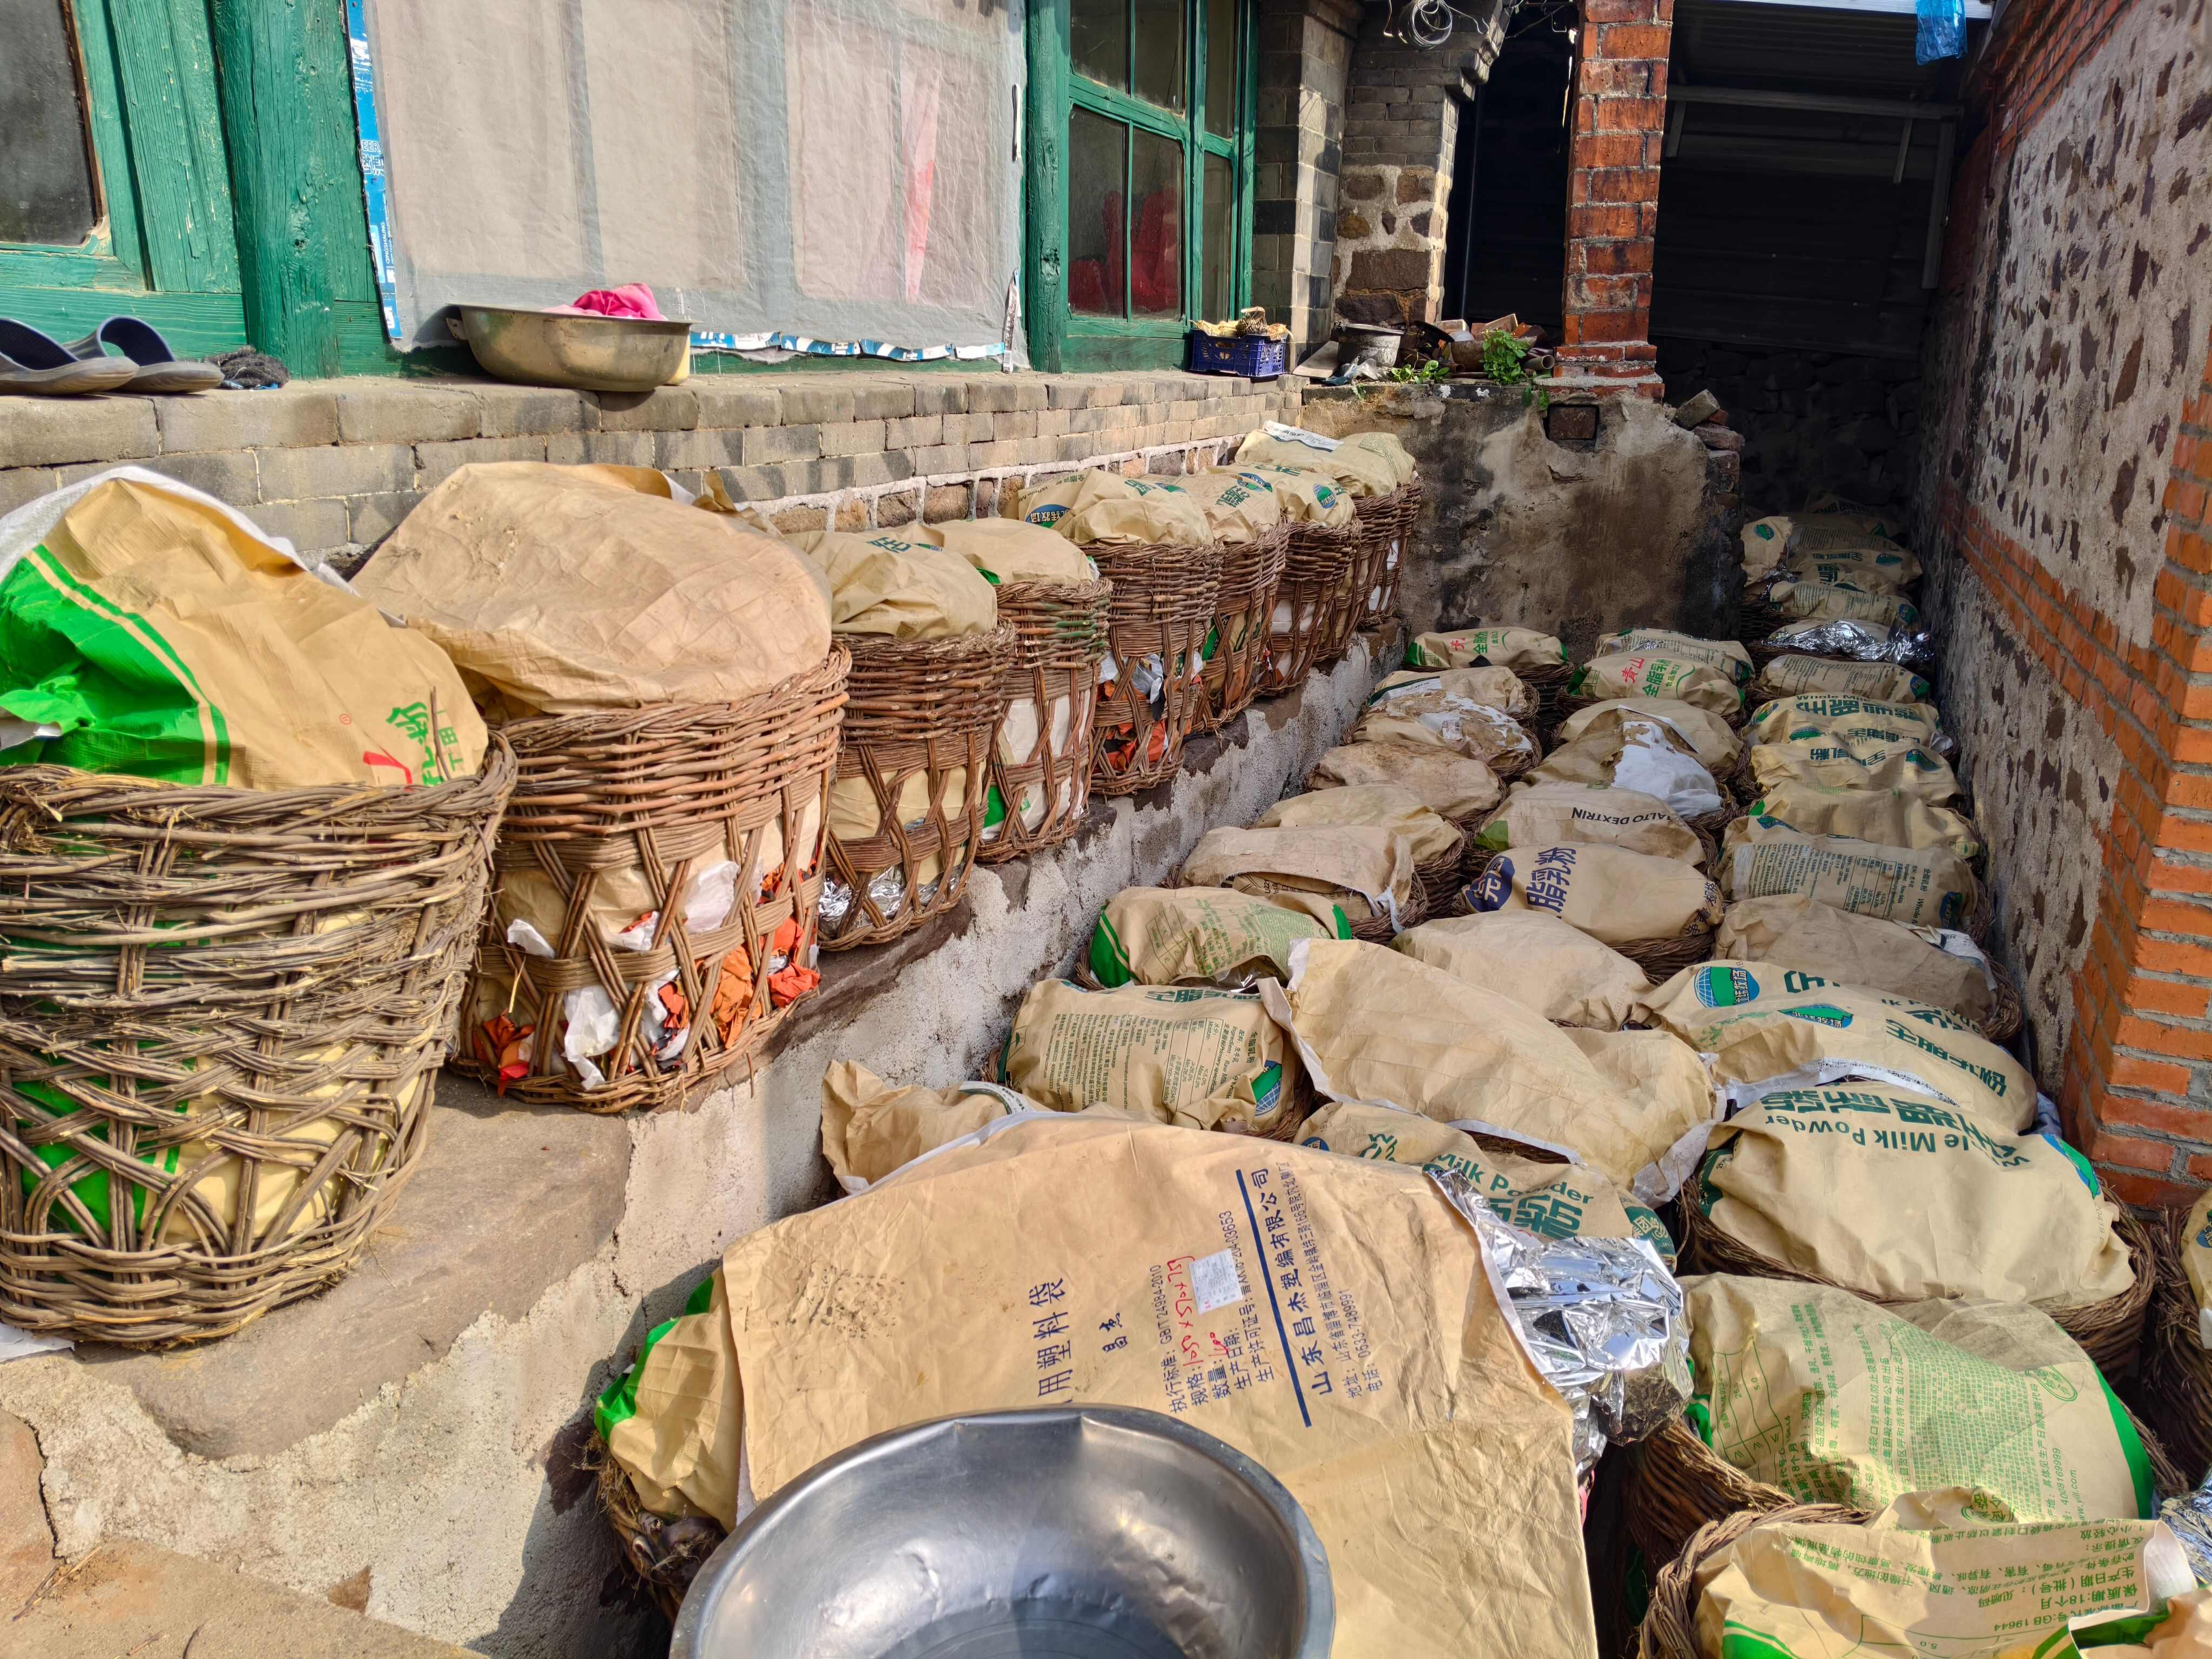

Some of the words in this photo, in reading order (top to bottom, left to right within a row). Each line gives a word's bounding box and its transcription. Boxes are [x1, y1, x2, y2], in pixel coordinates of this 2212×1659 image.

[361, 138, 381, 152] EER
[1621, 657, 1646, 684] 青山
[1571, 806, 1630, 826] DEXTRIN
[1526, 846, 1577, 919] 脂乳粉
[1764, 1114, 1866, 1147] Powder
[1874, 1130, 1937, 1154] Milk
[1435, 1152, 1487, 1185] Milk
[1251, 1168, 1334, 1396] 山东昌杰塑编有限公司
[1029, 1278, 1074, 1403] 用塑料袋
[2052, 1447, 2069, 1506] 4008169999
[2069, 1468, 2086, 1521] ww.yili.com
[1993, 1621, 2031, 1632] 19644
